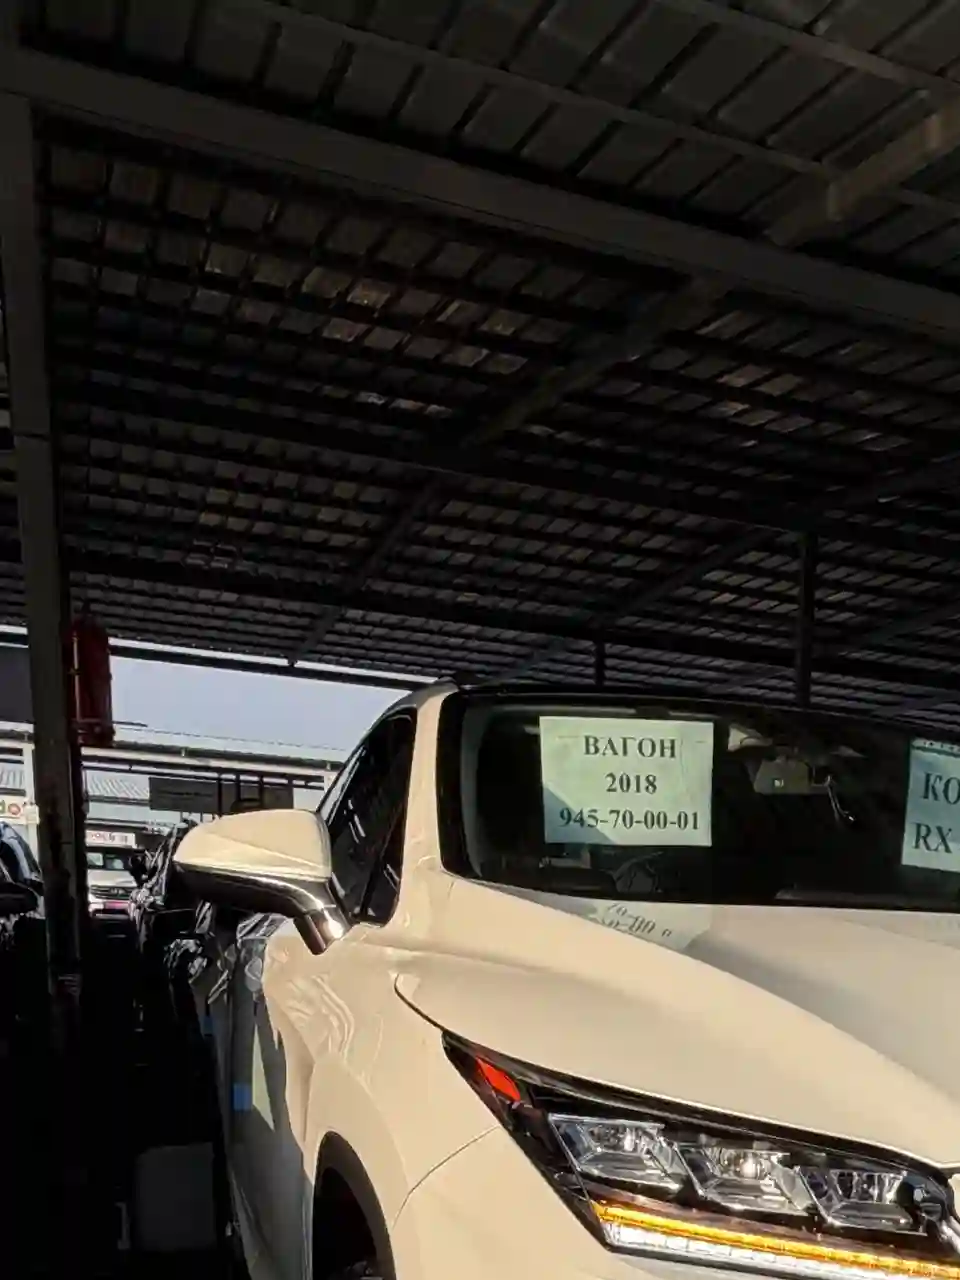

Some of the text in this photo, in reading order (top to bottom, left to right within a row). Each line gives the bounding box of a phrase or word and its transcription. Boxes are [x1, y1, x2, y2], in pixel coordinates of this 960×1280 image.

[583, 734, 677, 759] ВАГОН
[605, 772, 658, 795] 2018
[558, 807, 701, 831] 945-70-00-01
[914, 822, 953, 854] RX
